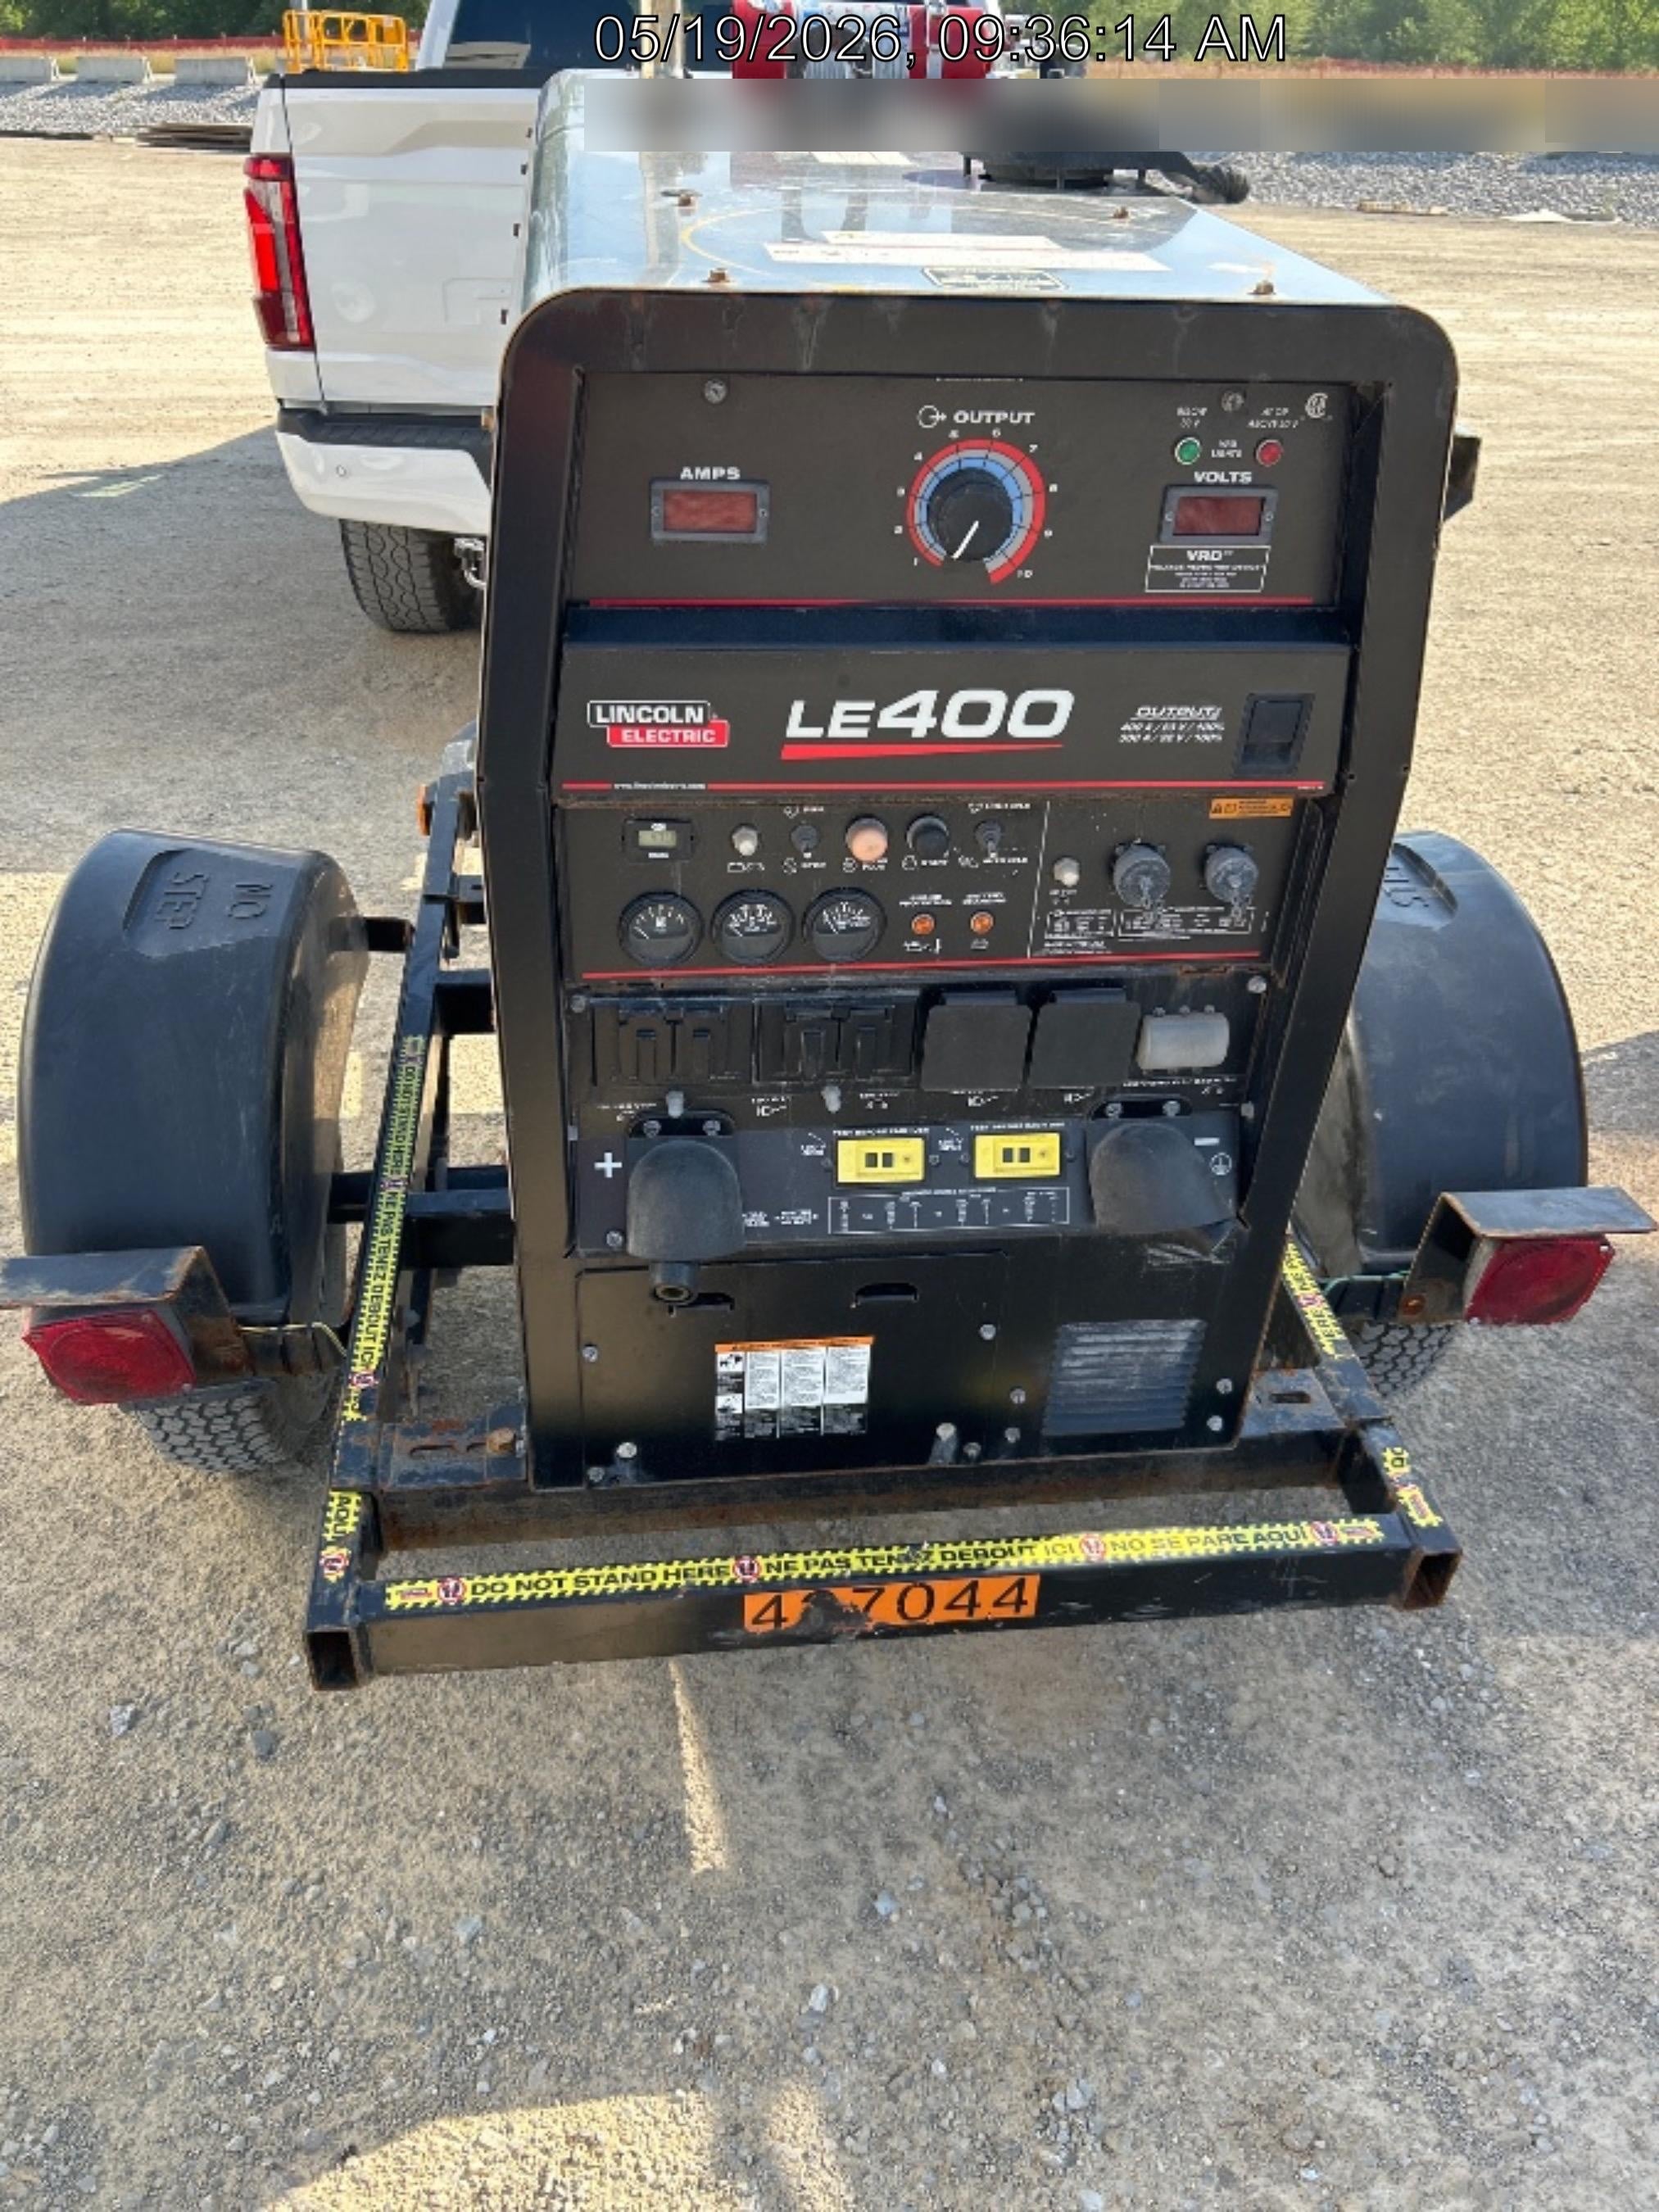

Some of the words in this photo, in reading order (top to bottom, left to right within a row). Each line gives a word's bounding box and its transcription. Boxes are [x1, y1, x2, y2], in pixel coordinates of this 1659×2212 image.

[954, 411, 1036, 424] OUTPUT
[680, 466, 741, 480] AMPS
[1194, 471, 1253, 483] VOLTS
[596, 705, 704, 723] LINCOLN
[785, 689, 1075, 738] LE400
[621, 729, 717, 743] ELECTRIC
[471, 1579, 507, 1596] DO
[515, 1575, 567, 1592] NOT
[574, 1569, 657, 1589] STAND
[663, 1564, 730, 1581] HERE
[766, 1559, 800, 1575] NE
[804, 1556, 851, 1571] PAS
[856, 1551, 933, 1567] TENZ
[941, 1544, 1037, 1562] DEBOUT
[1043, 1543, 1075, 1557] ICI
[1109, 1537, 1145, 1552] NO
[1150, 1534, 1182, 1549] SE
[1186, 1530, 1248, 1547] PARE
[751, 1576, 1028, 1630] 47044
